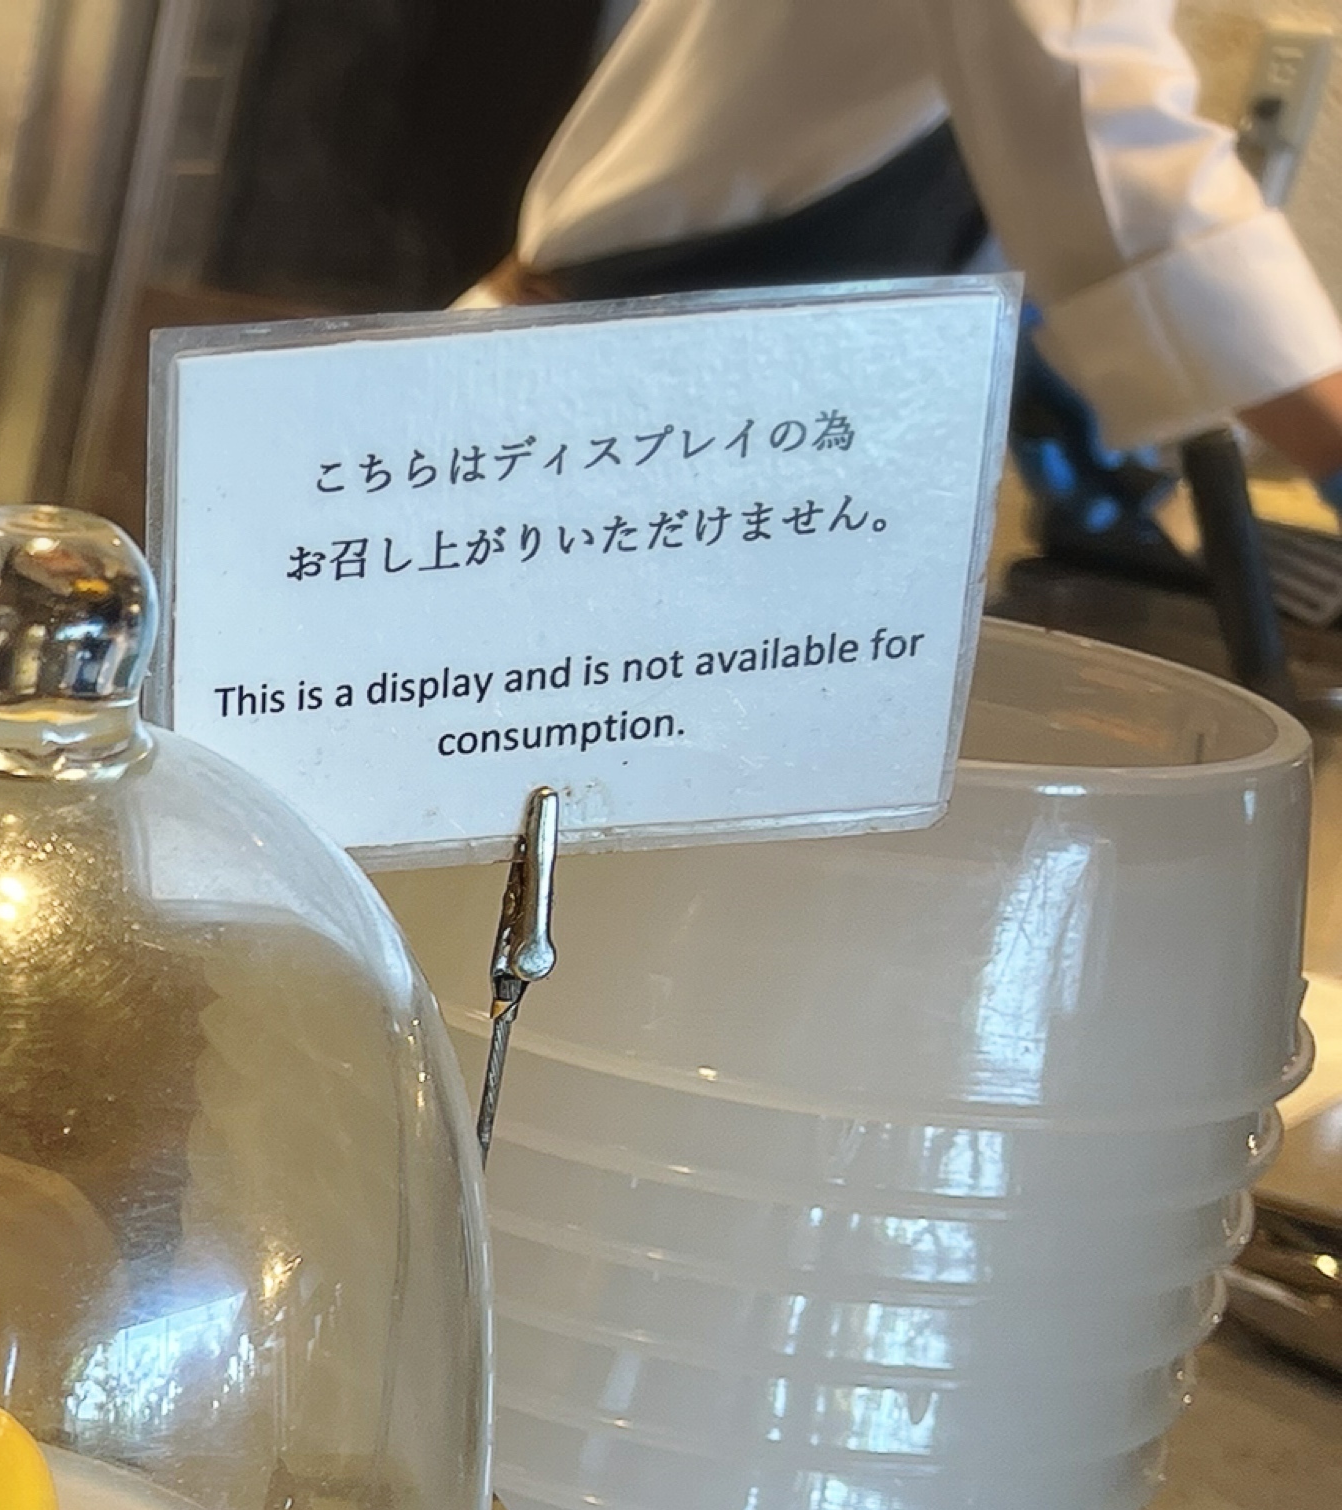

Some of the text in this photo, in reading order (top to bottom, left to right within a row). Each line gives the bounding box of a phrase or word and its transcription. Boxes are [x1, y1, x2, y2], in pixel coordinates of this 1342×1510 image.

[316, 409, 854, 492] こちらはディスプレイの為
[286, 494, 888, 581] お召し上がりいただけません。
[214, 627, 924, 718] This is a display and is not available for
[437, 710, 685, 756] consumption.
